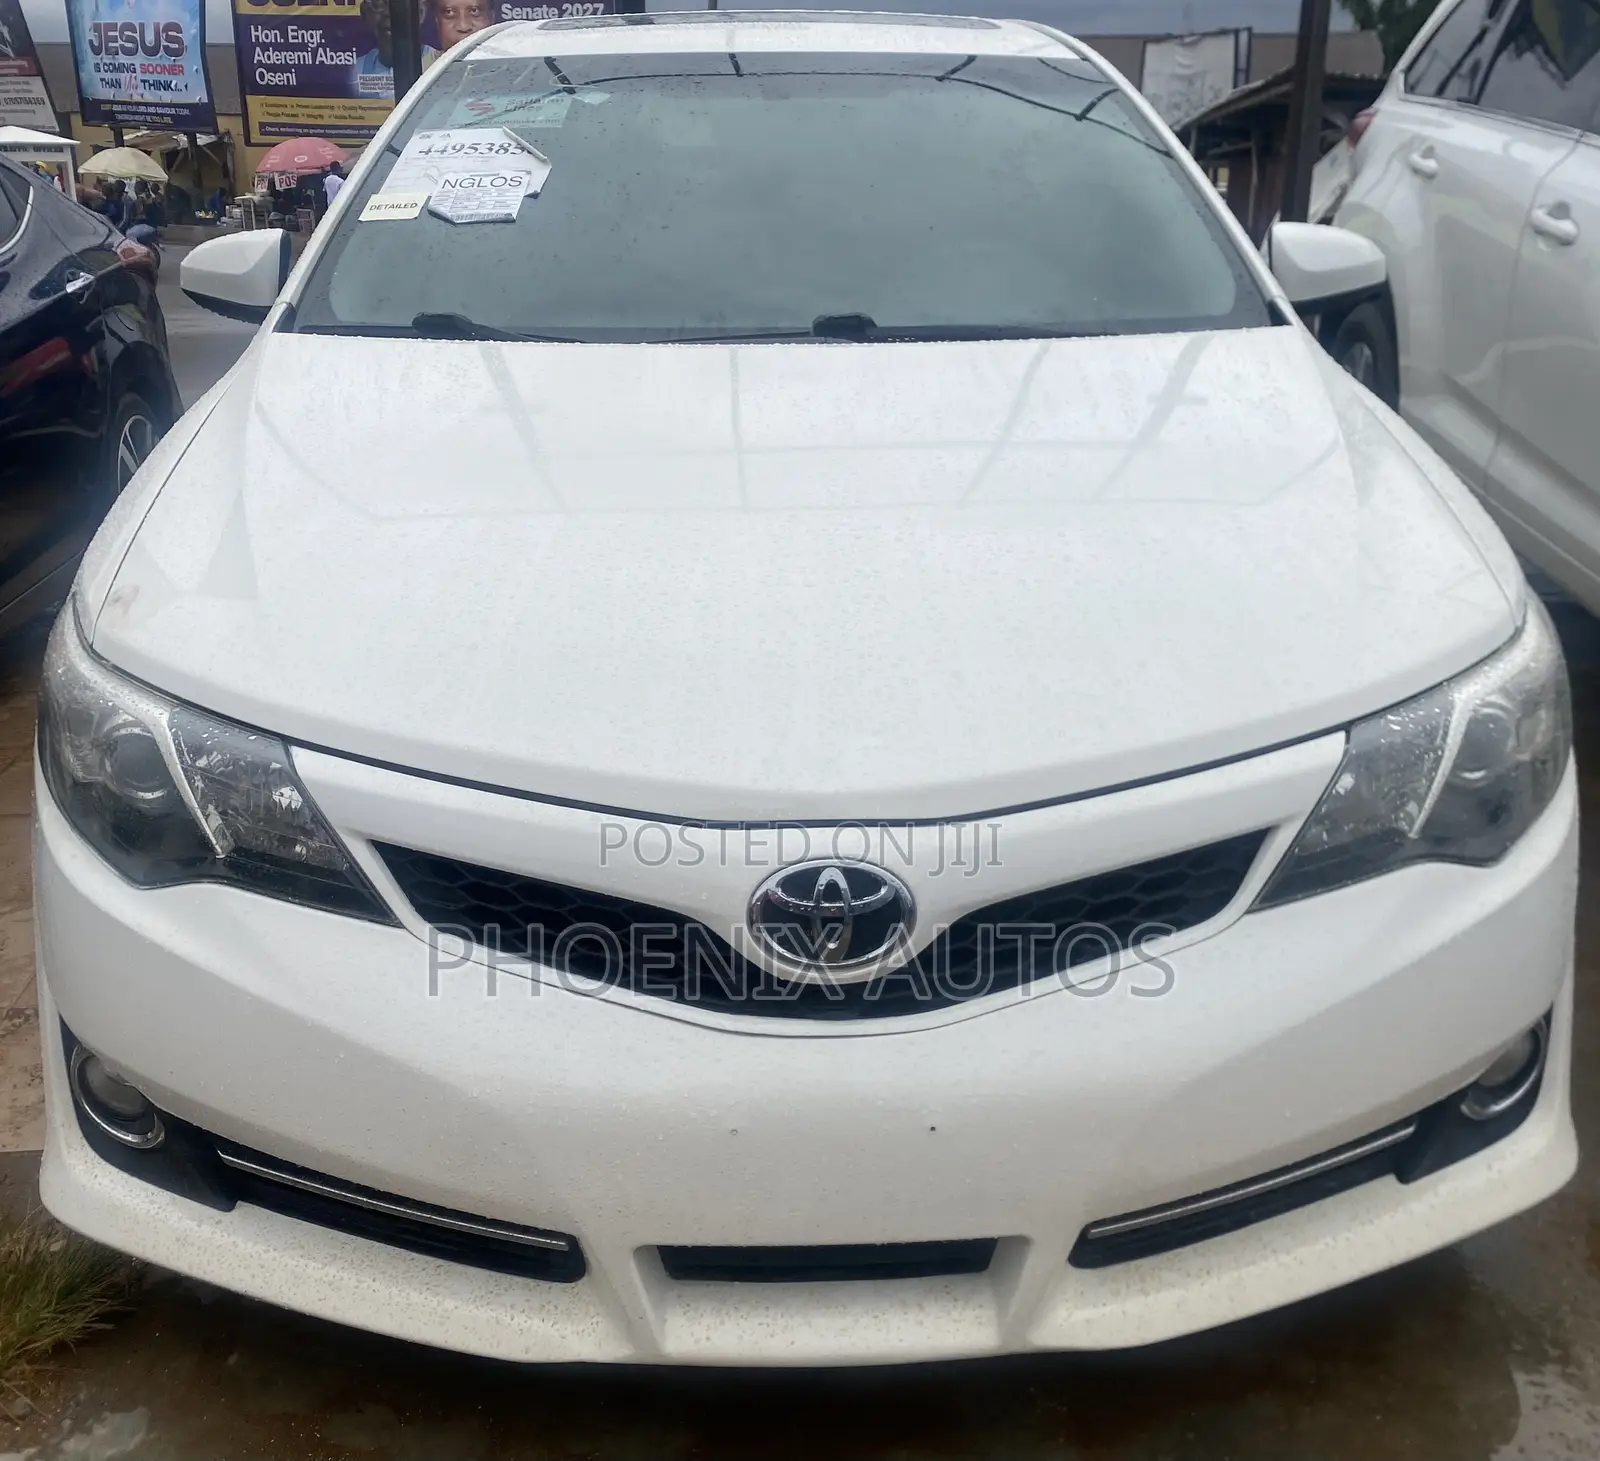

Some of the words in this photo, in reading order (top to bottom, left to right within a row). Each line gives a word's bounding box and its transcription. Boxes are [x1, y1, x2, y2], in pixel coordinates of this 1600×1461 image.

[501, 3, 559, 20] Senate
[561, 3, 605, 18] 2027
[88, 21, 187, 58] JESUS
[251, 25, 284, 43] Hon.
[288, 25, 325, 48] Engr.
[254, 47, 312, 65] Aderemi
[315, 47, 357, 65] Abasi
[94, 62, 101, 73] IS
[103, 62, 136, 74] COMING
[139, 63, 185, 76] SOONER
[99, 77, 122, 89] THAN
[255, 68, 297, 86] Oseni
[279, 174, 297, 188] POS
[442, 176, 523, 189] NGLOS
[368, 202, 418, 211] DETAILED
